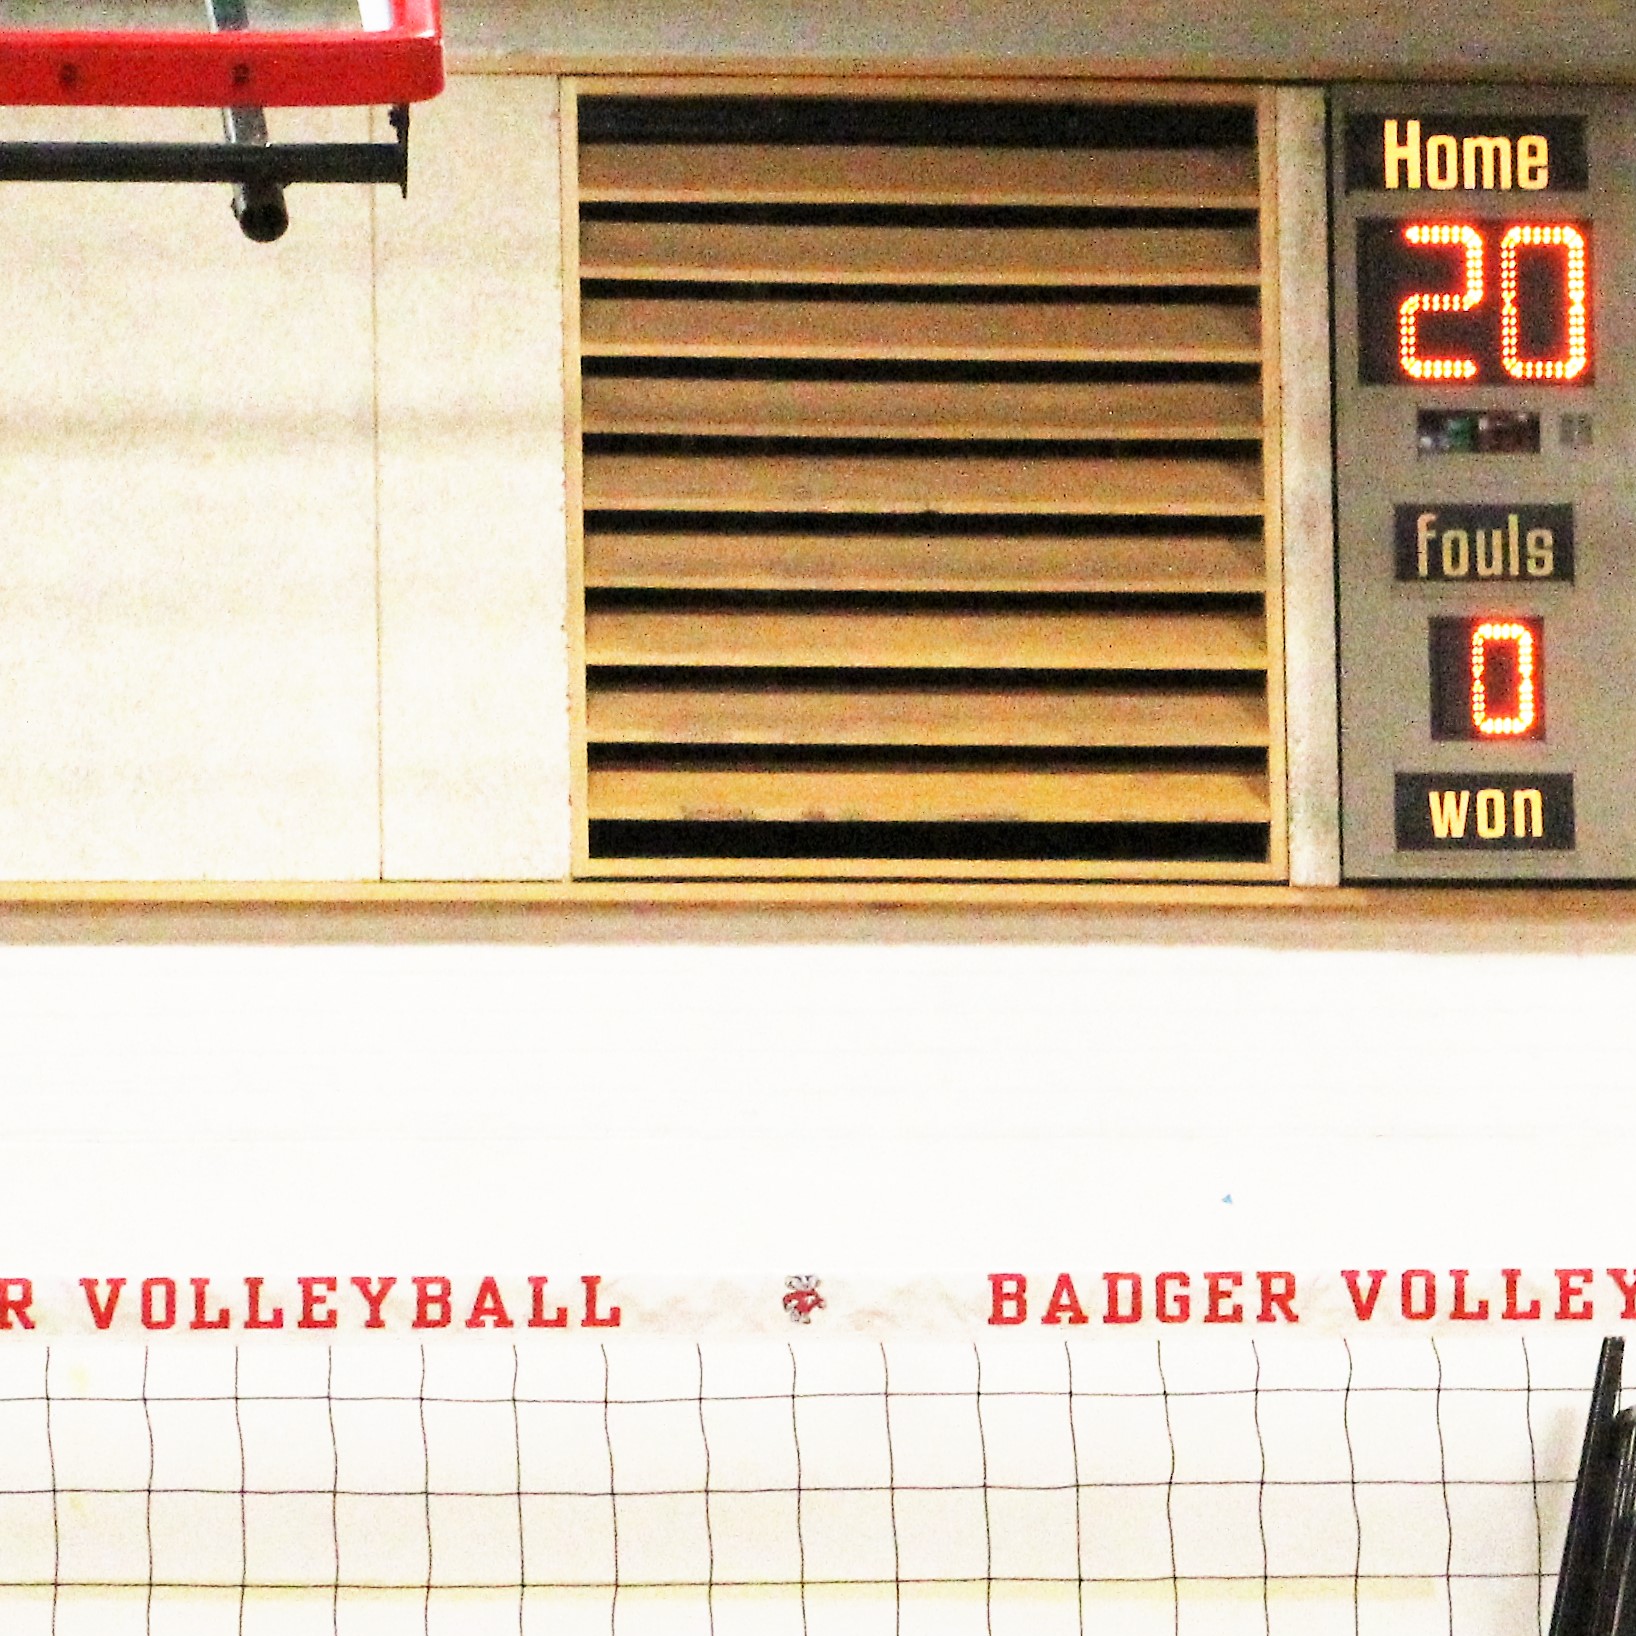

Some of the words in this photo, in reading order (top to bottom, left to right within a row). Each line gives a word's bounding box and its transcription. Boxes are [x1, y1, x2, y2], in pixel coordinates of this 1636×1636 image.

[1383, 119, 1550, 192] Home
[1398, 224, 1588, 381] 20
[1416, 514, 1554, 580] fouls
[1469, 621, 1535, 737] 0
[1428, 785, 1545, 841] won
[79, 1276, 622, 1330] VOLLEYBALL
[987, 1271, 1300, 1326] BADGER
